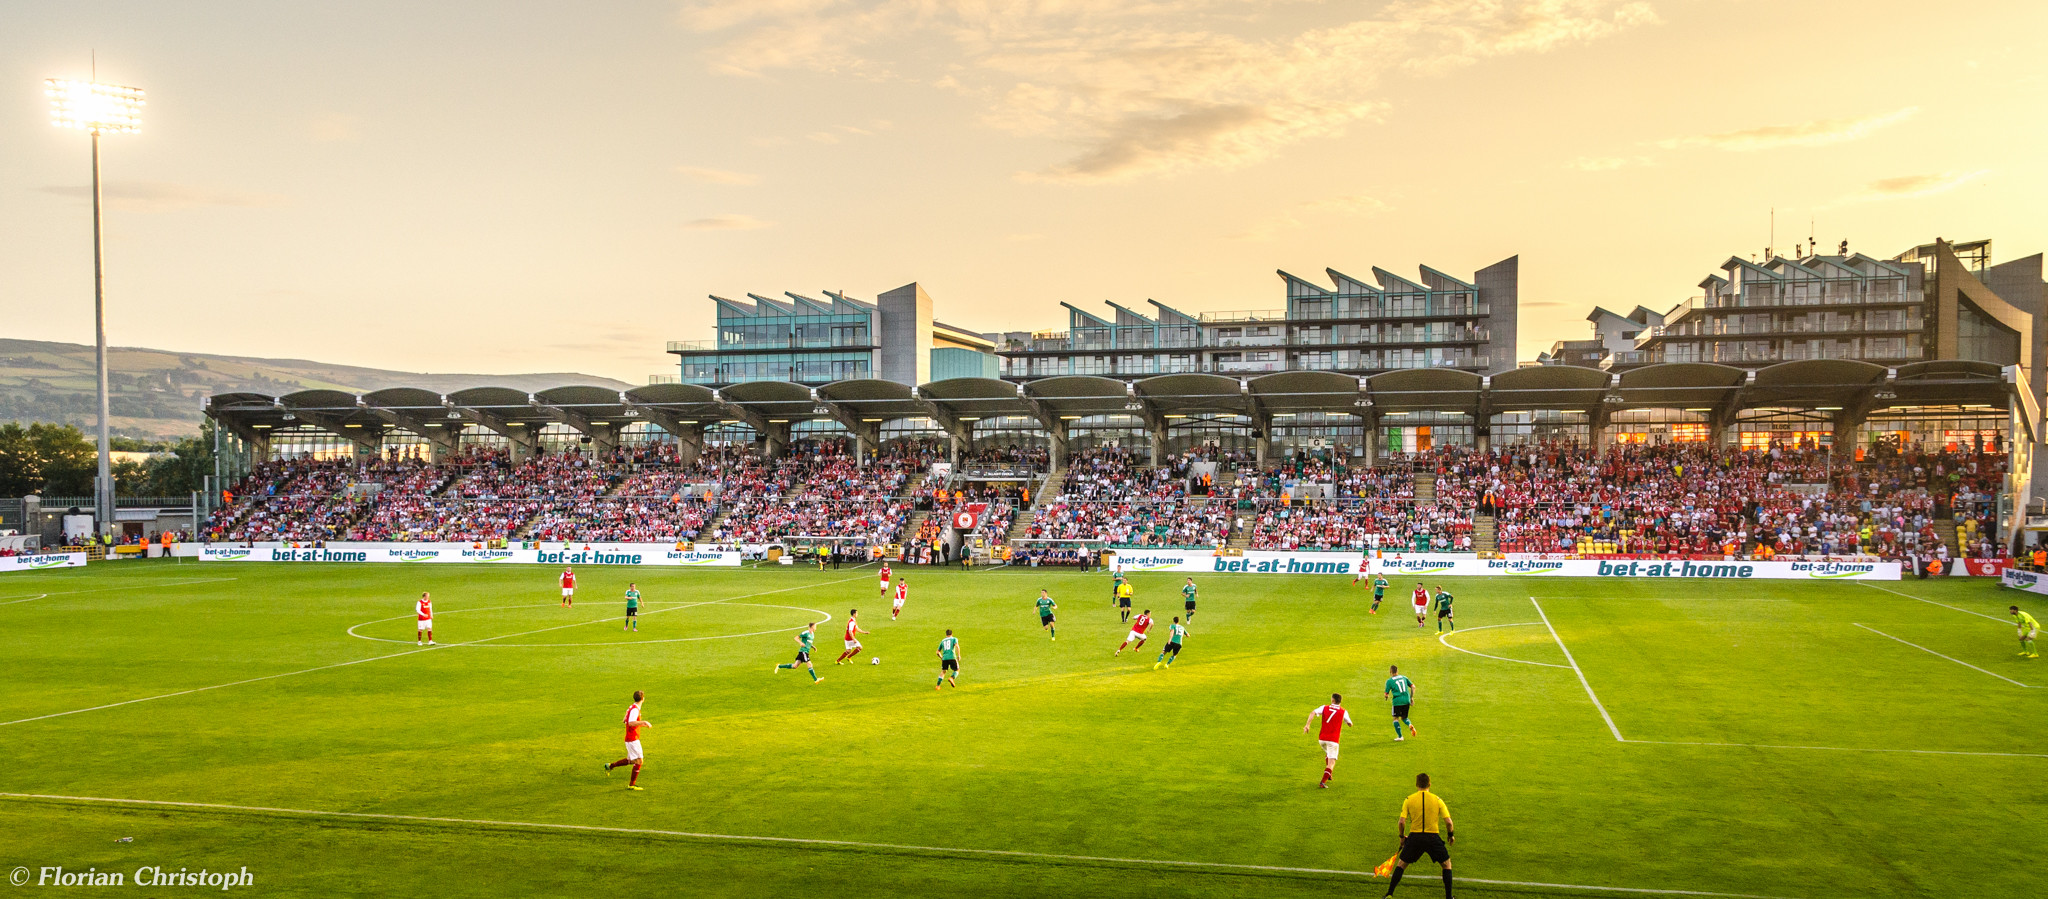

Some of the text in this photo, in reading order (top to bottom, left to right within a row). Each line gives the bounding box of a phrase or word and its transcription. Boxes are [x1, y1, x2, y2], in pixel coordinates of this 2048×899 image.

[1313, 439, 1320, 447] G
[204, 548, 251, 556] bet-at-home
[272, 549, 367, 562] bet-at-home
[389, 549, 439, 557] bet-at-home
[462, 549, 513, 557] bet-at-home
[667, 551, 723, 560] bet-at-home
[17, 554, 71, 564] bet-at-home
[537, 550, 642, 565] bet-at-home
[1117, 556, 1184, 565] bet-at-home
[1213, 557, 1350, 574] bet-at-home
[1382, 559, 1455, 568] bet-at-home
[1487, 559, 1563, 569] bet-at-home
[1791, 562, 1874, 572] bet-at-home
[1597, 560, 1753, 578] bet-at-home
[1138, 615, 1146, 626] 9
[943, 640, 951, 650] 18
[1395, 679, 1406, 693] 17
[1326, 708, 1337, 723] 7
